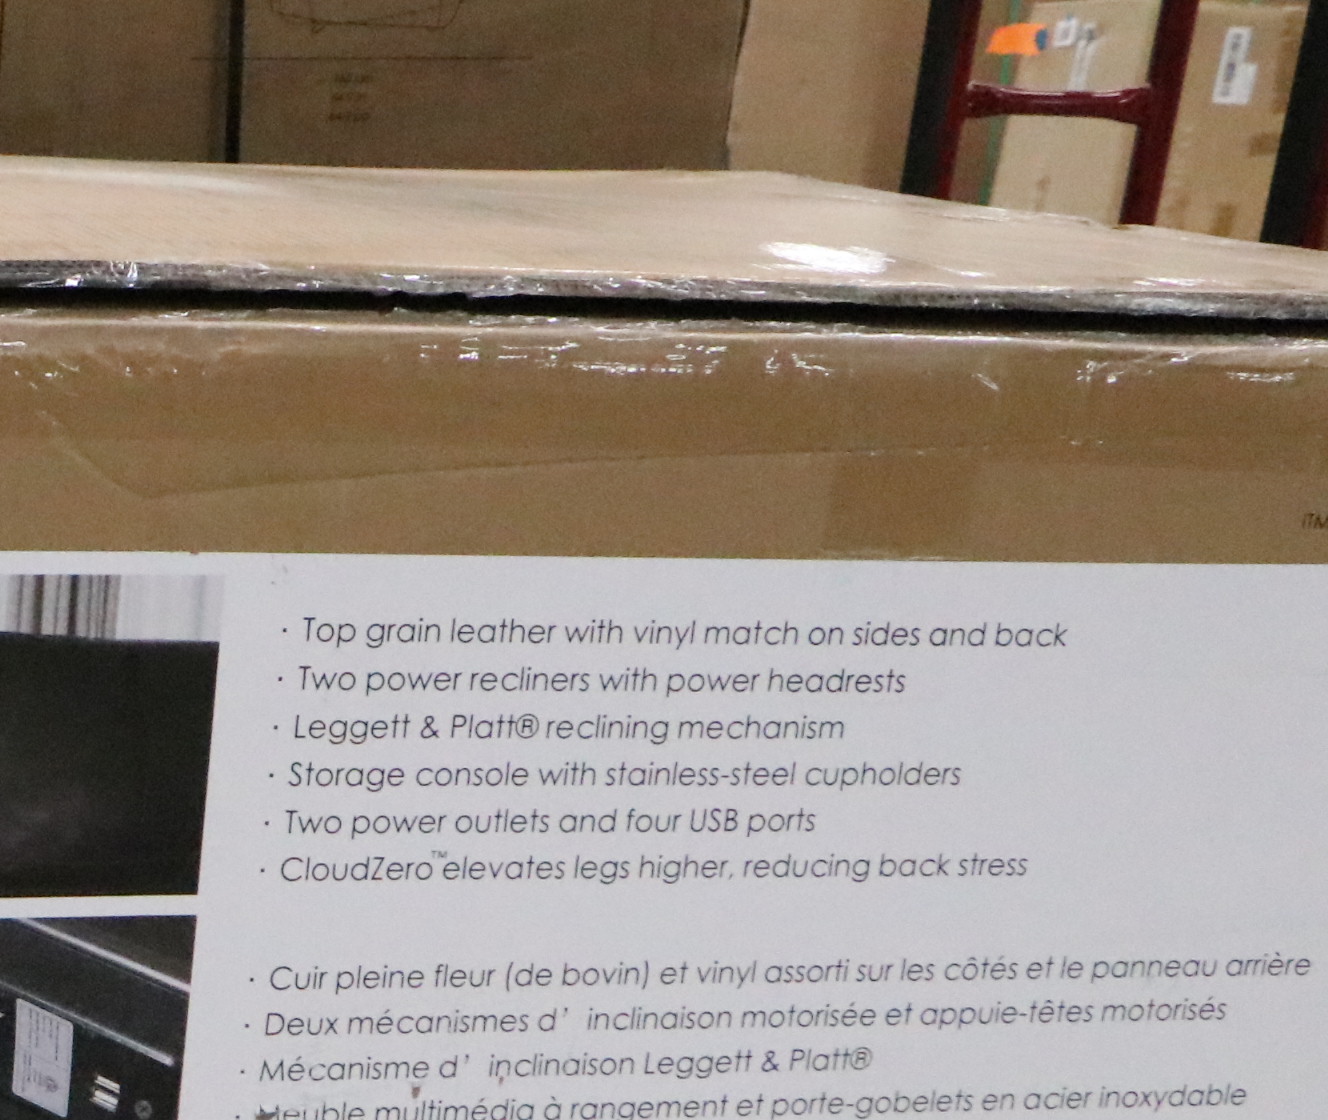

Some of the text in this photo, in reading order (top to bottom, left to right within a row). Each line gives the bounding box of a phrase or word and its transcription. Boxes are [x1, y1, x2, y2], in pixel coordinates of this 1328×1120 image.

[303, 617, 1067, 650] Top grain leather with vinyl match on sides and back
[299, 665, 906, 697] Two power recliners with power headrests
[288, 761, 961, 793] Storage console with stainless-steel cupholders
[264, 996, 1227, 1036] Deux mécanismes inclinaison motorisée et appuie-têtes motorisés
